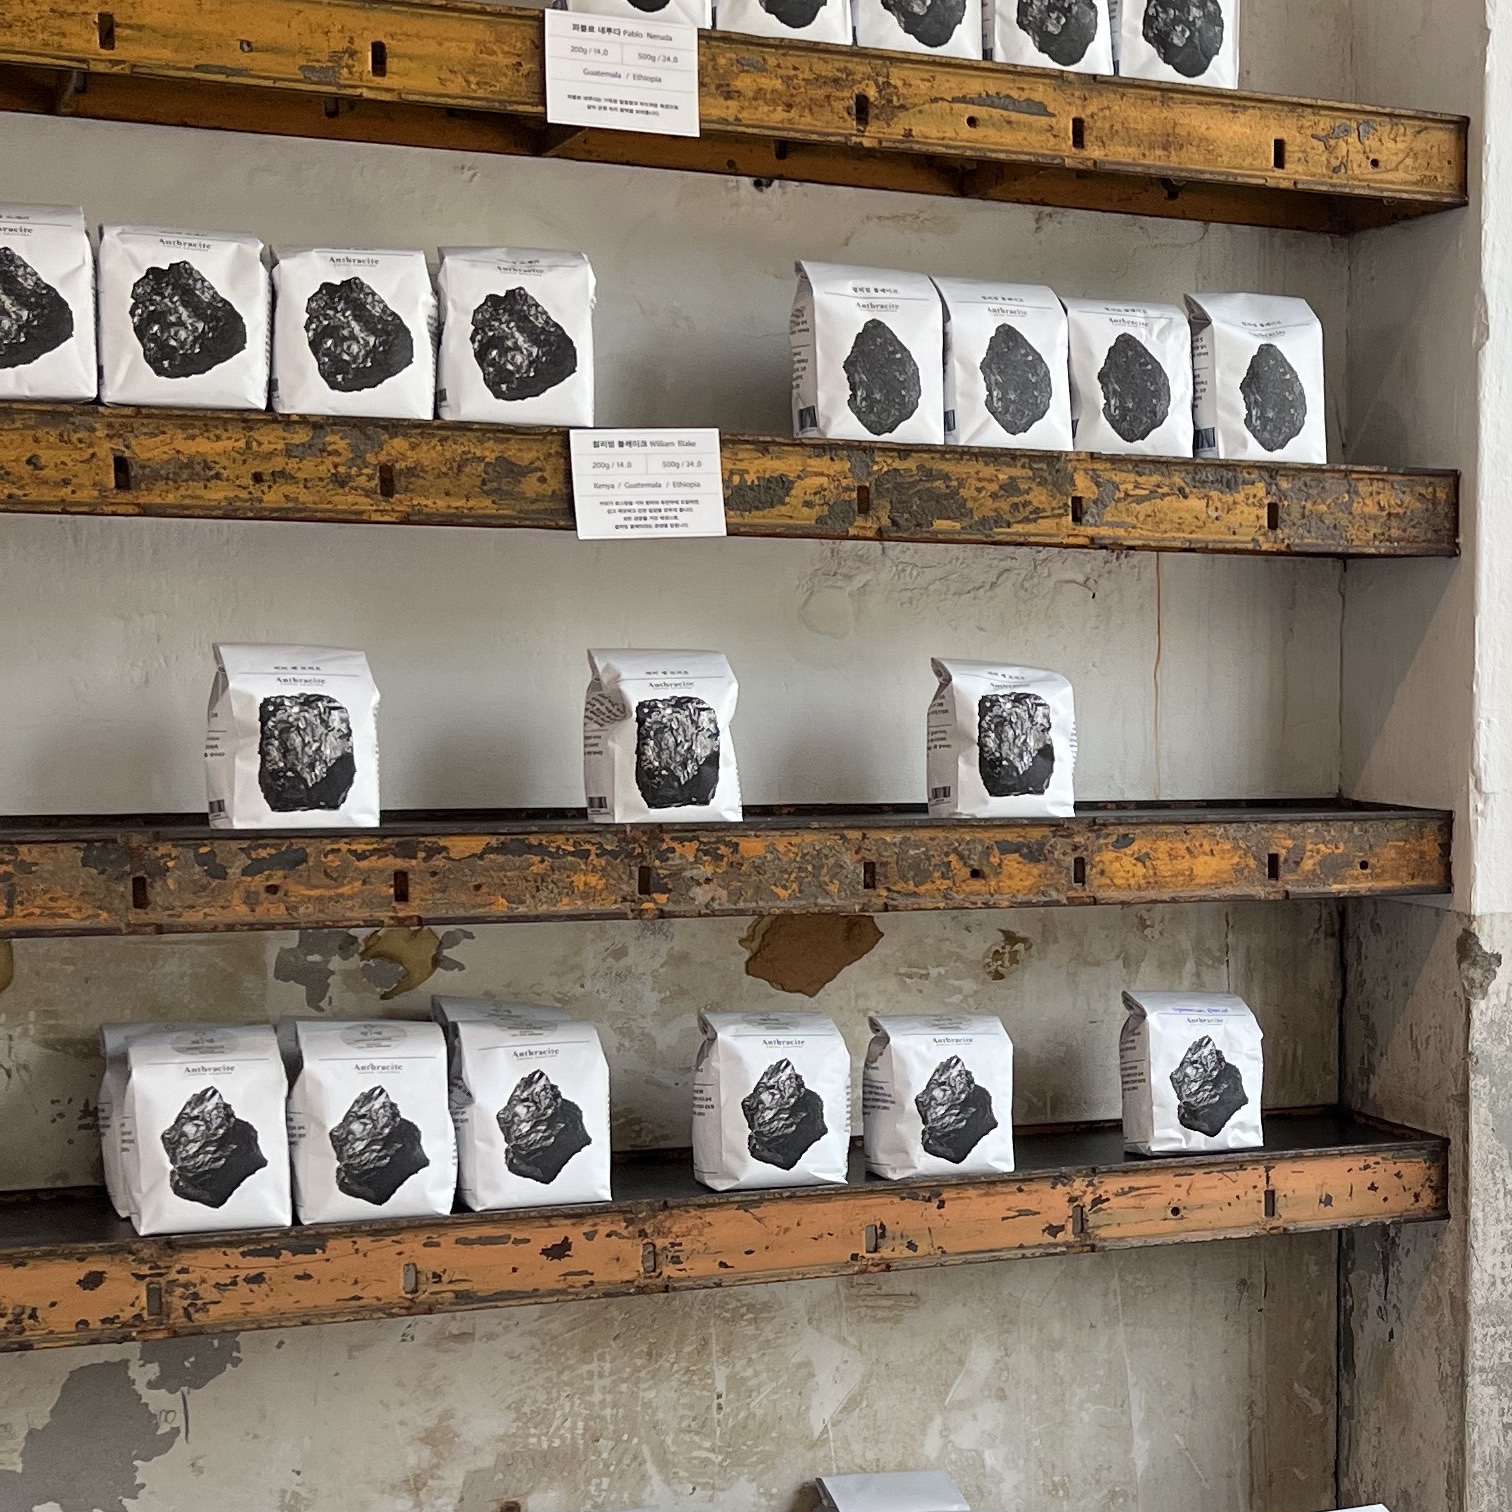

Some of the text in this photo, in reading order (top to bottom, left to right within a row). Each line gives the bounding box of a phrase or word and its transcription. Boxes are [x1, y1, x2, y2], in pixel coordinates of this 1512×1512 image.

[622, 30, 644, 39] Pablo
[646, 32, 672, 42] Neruda
[638, 53, 656, 63] 500g
[583, 68, 622, 80] Guatemala
[632, 74, 662, 84] Ethiopia
[330, 256, 380, 265] Anthracite
[650, 440, 676, 448] William
[678, 440, 696, 448] Blake
[592, 462, 610, 470] 200g
[662, 462, 680, 470] 500g
[594, 482, 615, 491] Kenya
[624, 482, 662, 490] Guatemala
[672, 482, 702, 490] Ethiopia
[513, 1048, 560, 1058] Anthracite
[184, 1064, 235, 1073] Anthracite
[354, 1062, 402, 1070] Anthracite
